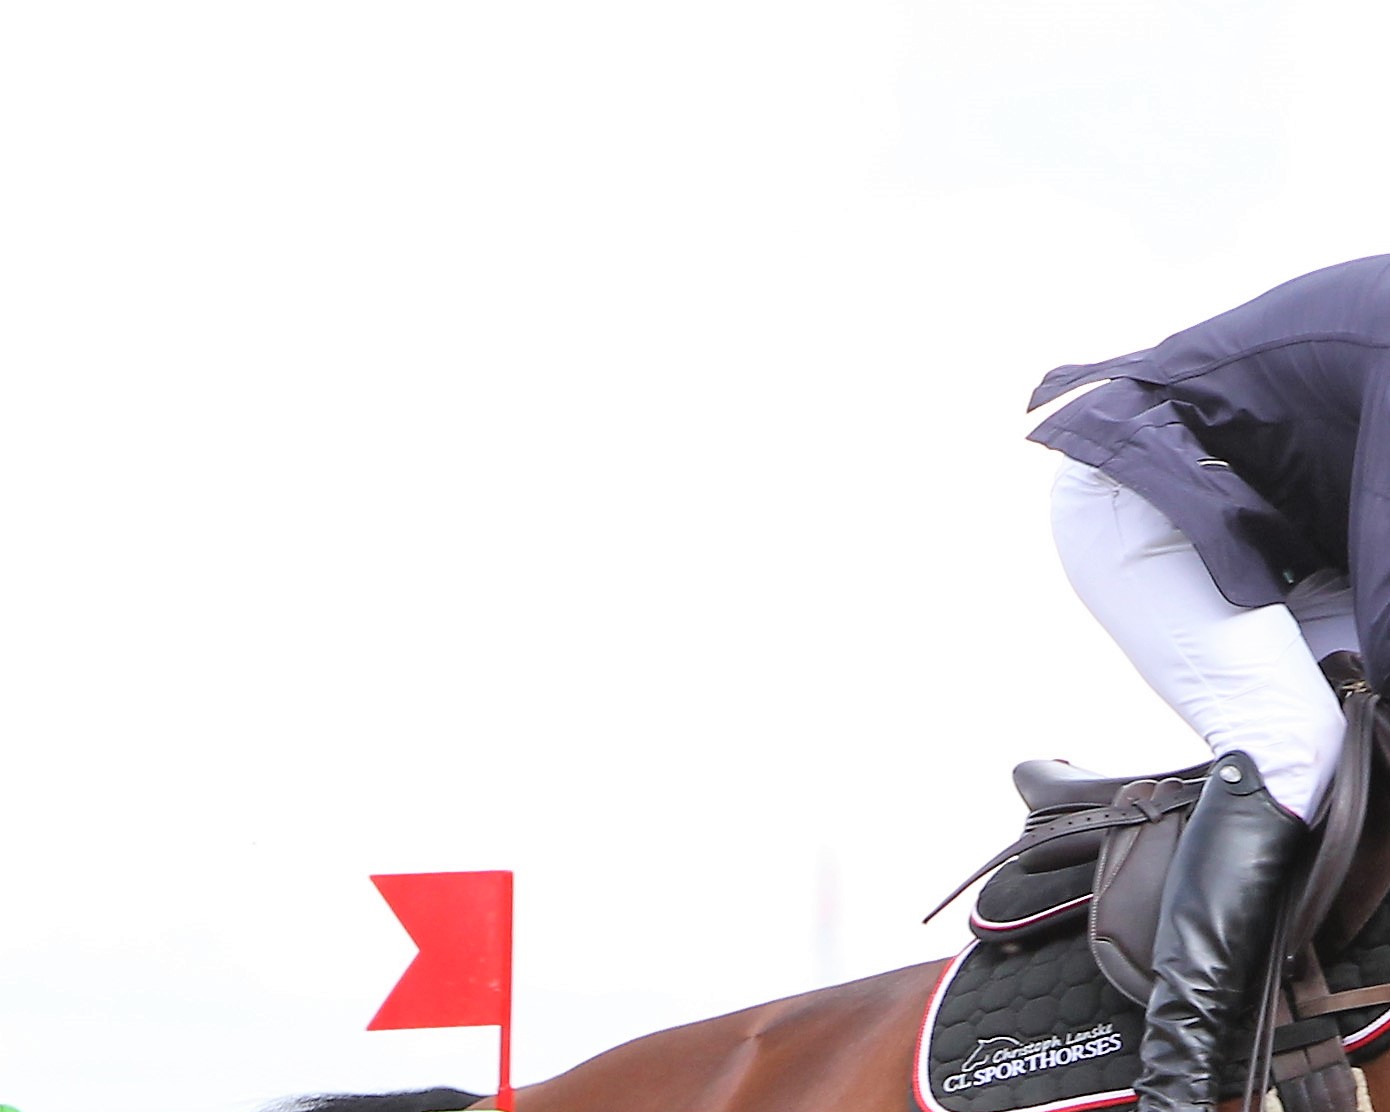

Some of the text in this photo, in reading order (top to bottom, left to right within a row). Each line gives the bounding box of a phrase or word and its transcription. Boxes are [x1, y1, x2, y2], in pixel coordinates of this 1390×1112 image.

[943, 1033, 1122, 1093] CL SPORTHORSES
[993, 1036, 1062, 1064] Christoph
